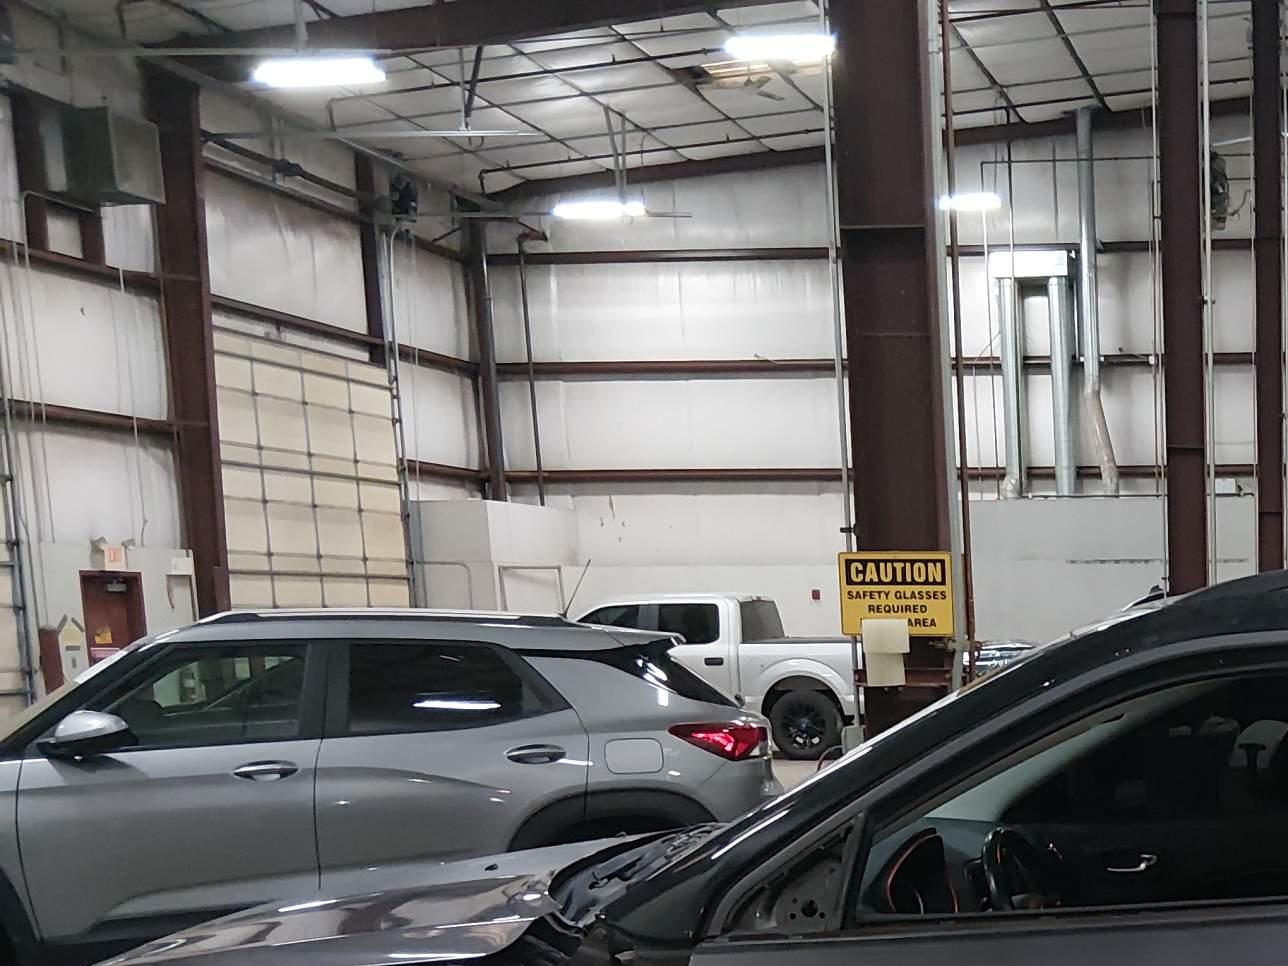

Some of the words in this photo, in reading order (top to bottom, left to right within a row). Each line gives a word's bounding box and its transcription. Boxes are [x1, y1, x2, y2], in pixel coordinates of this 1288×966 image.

[850, 561, 942, 583] CAUTION
[847, 590, 891, 600] SAFETY
[894, 590, 947, 600] GLASSES
[867, 604, 928, 614] REQUIRED
[908, 618, 937, 628] AREA
